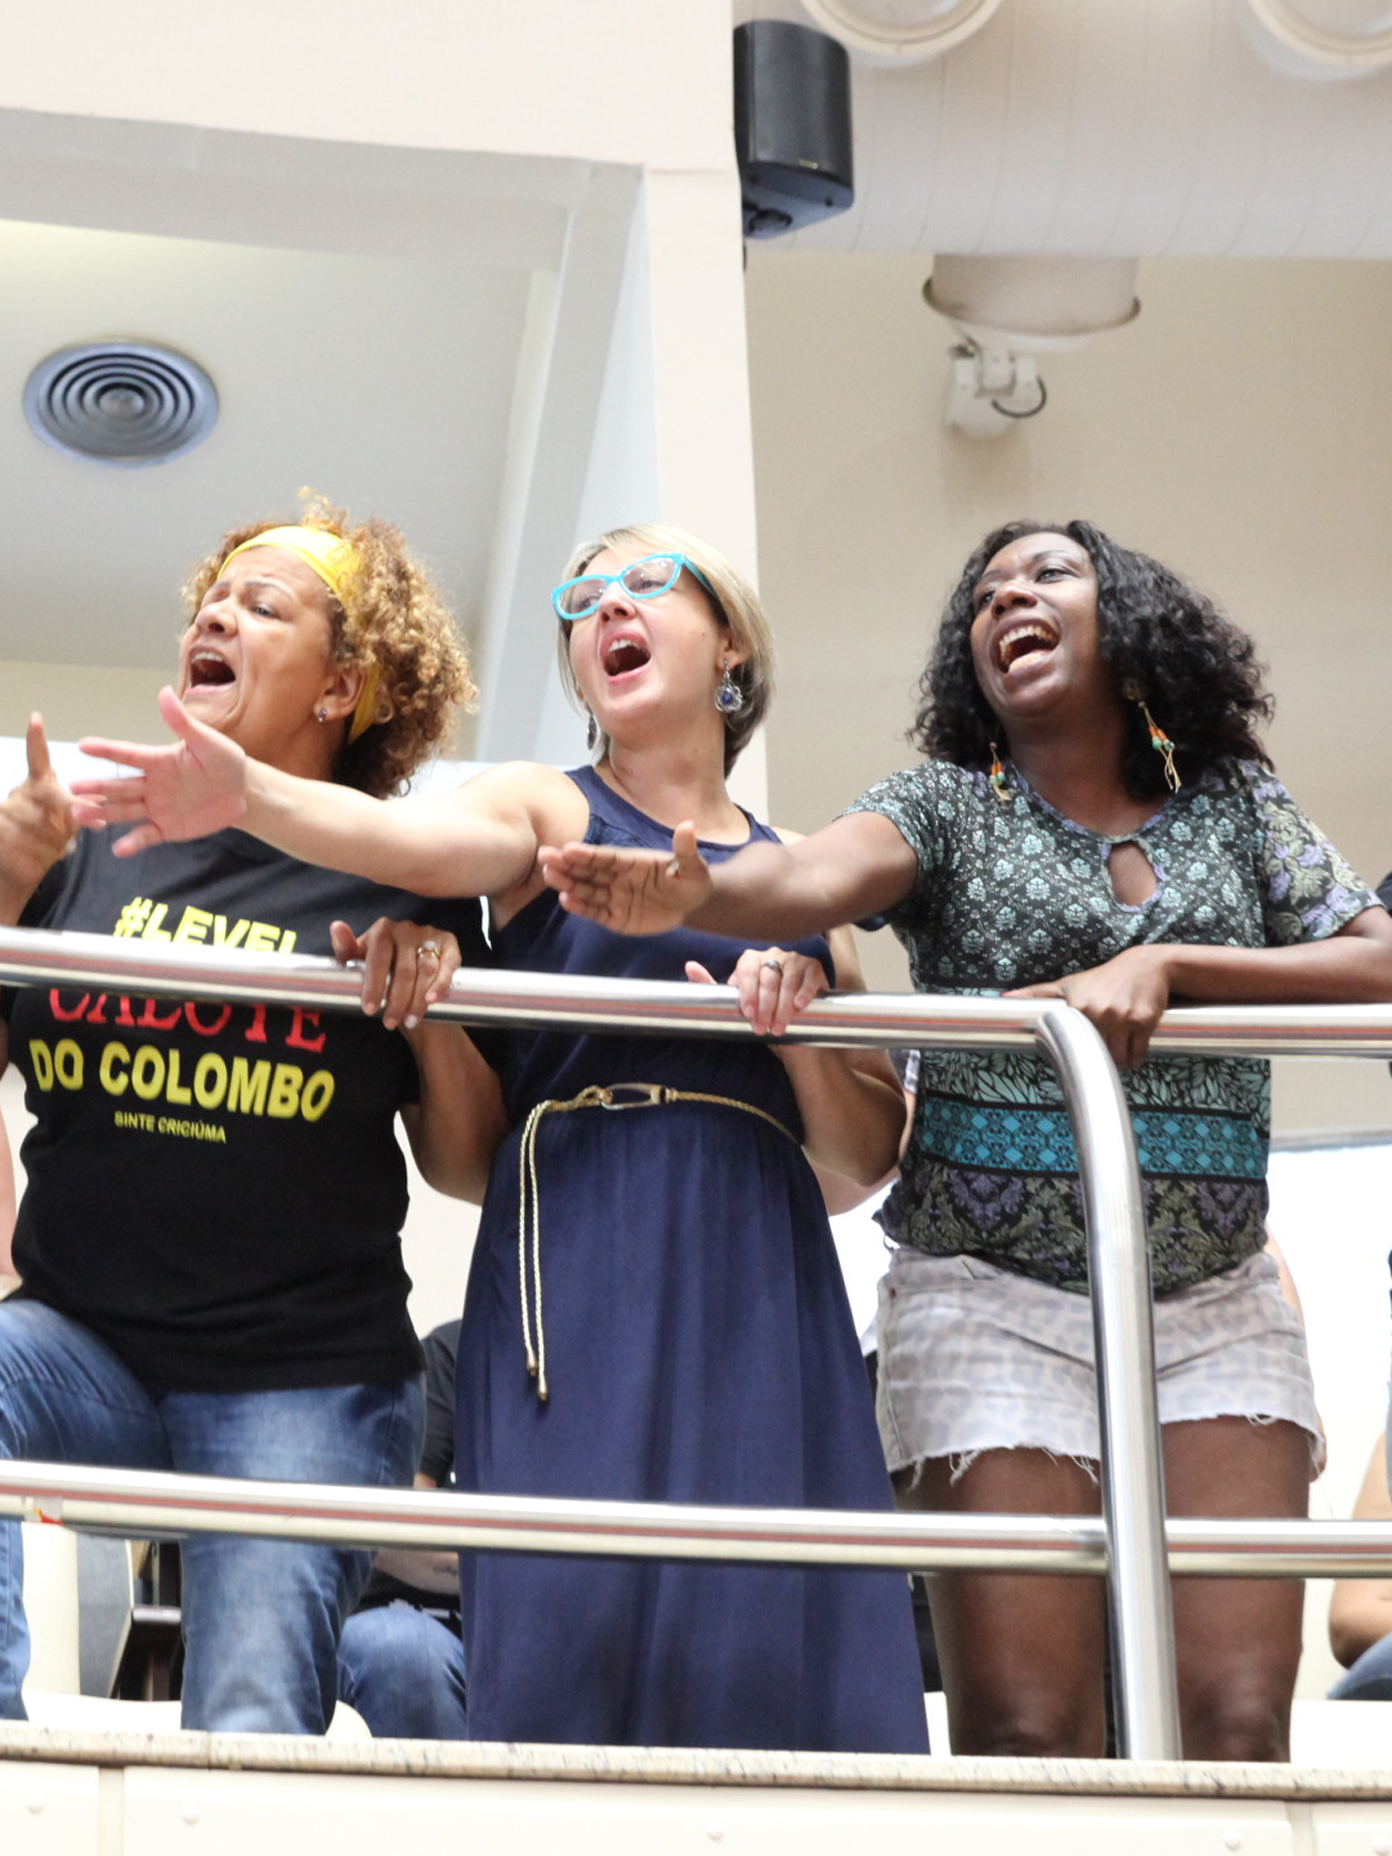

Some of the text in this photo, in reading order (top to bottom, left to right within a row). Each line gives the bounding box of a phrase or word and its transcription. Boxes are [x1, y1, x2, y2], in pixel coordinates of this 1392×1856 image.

[30, 1039, 335, 1122] DO COLOMBO
[114, 1111, 155, 1133] SINTE
